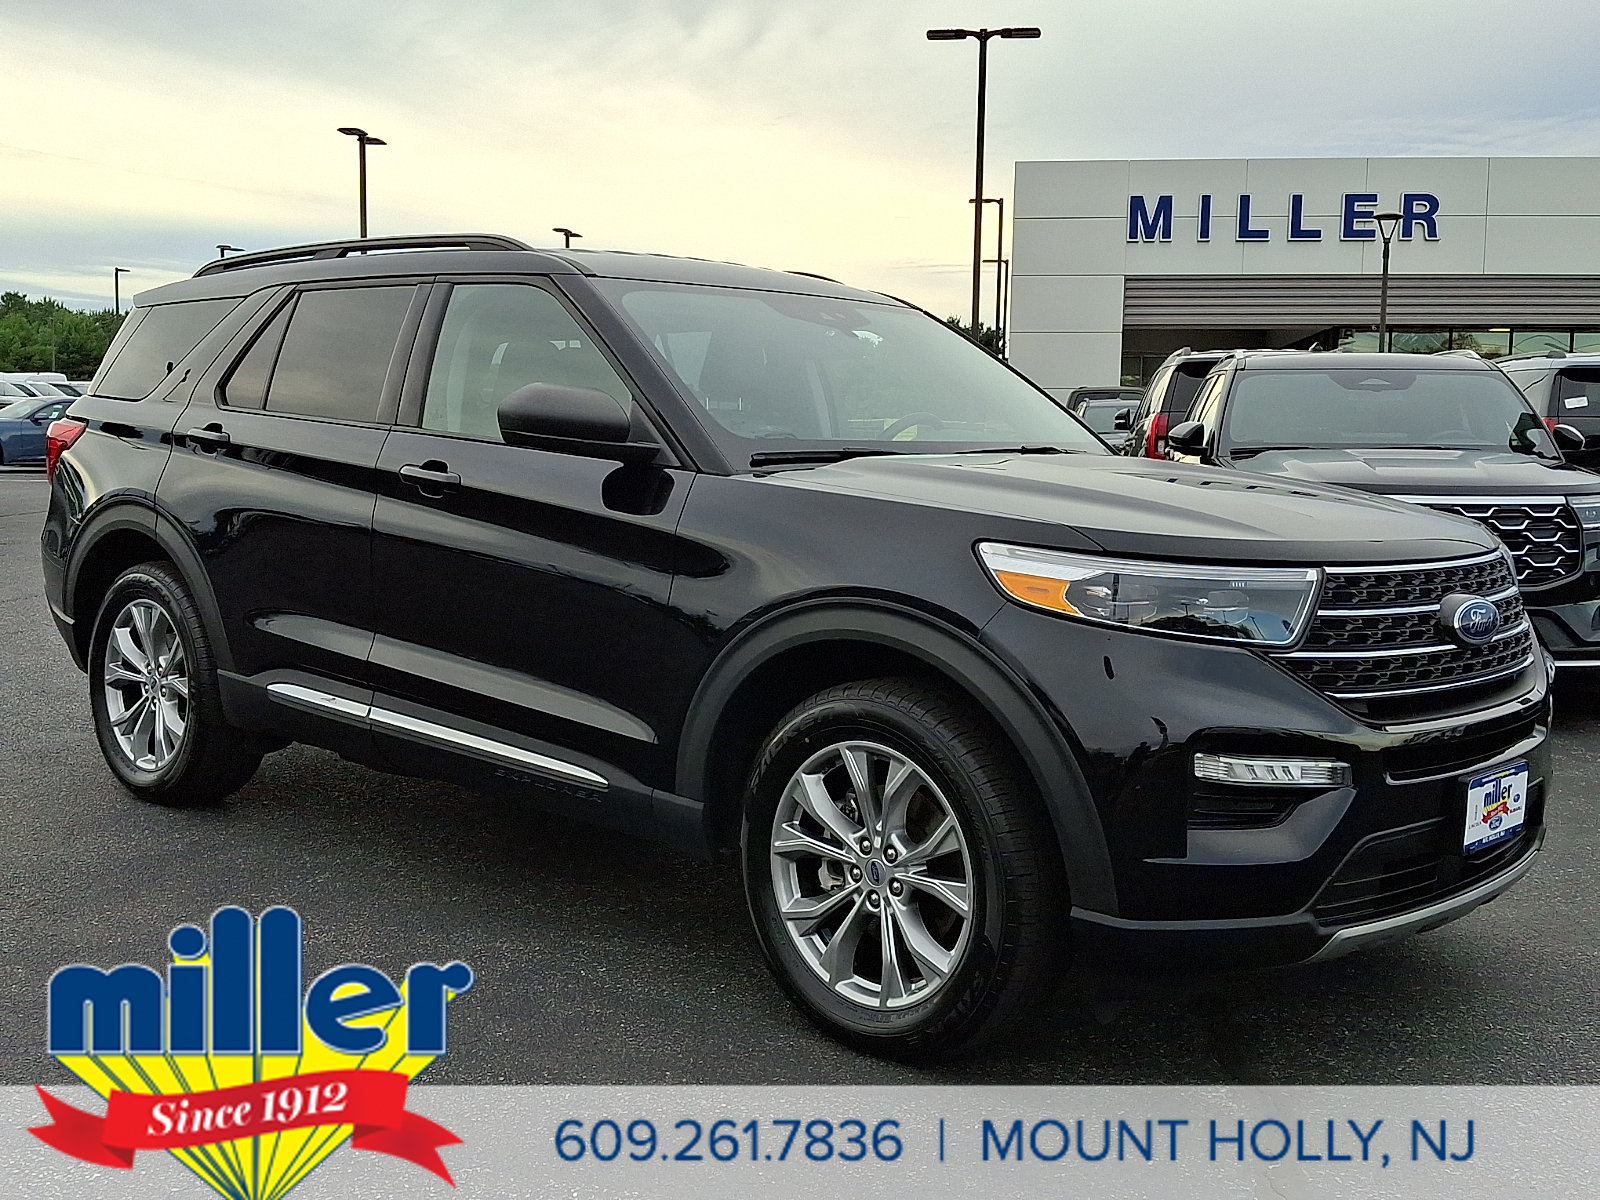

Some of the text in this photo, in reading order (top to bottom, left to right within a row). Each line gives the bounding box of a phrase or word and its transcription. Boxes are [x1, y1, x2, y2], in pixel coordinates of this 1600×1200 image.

[1126, 191, 1442, 242] MILLER
[1470, 608, 1494, 634] Ford
[1483, 778, 1513, 808] miller
